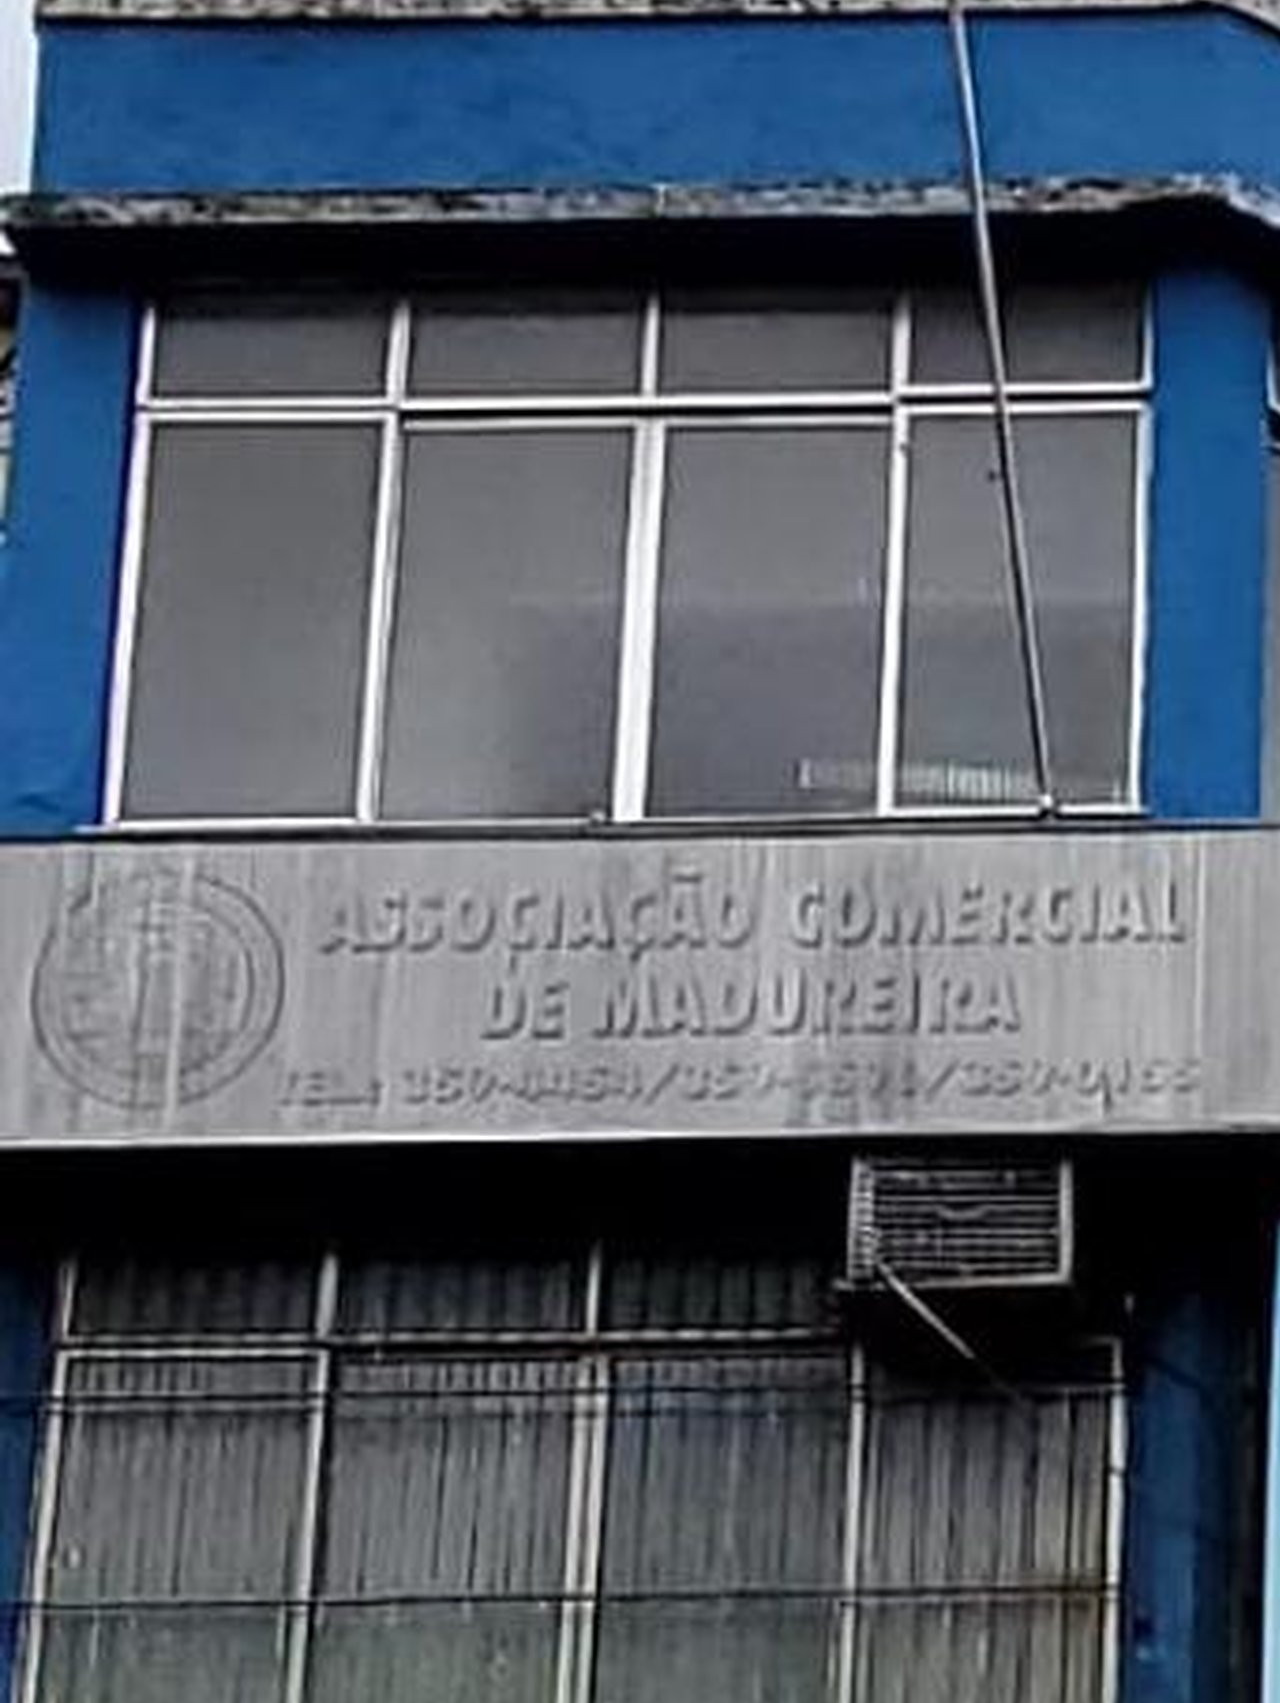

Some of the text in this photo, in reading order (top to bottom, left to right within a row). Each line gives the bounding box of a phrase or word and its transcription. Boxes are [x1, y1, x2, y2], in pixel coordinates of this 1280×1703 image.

[318, 874, 1188, 968] ASSOCIAÇÃO COMERCIAL
[478, 970, 1022, 1041] DE MADUREIRA
